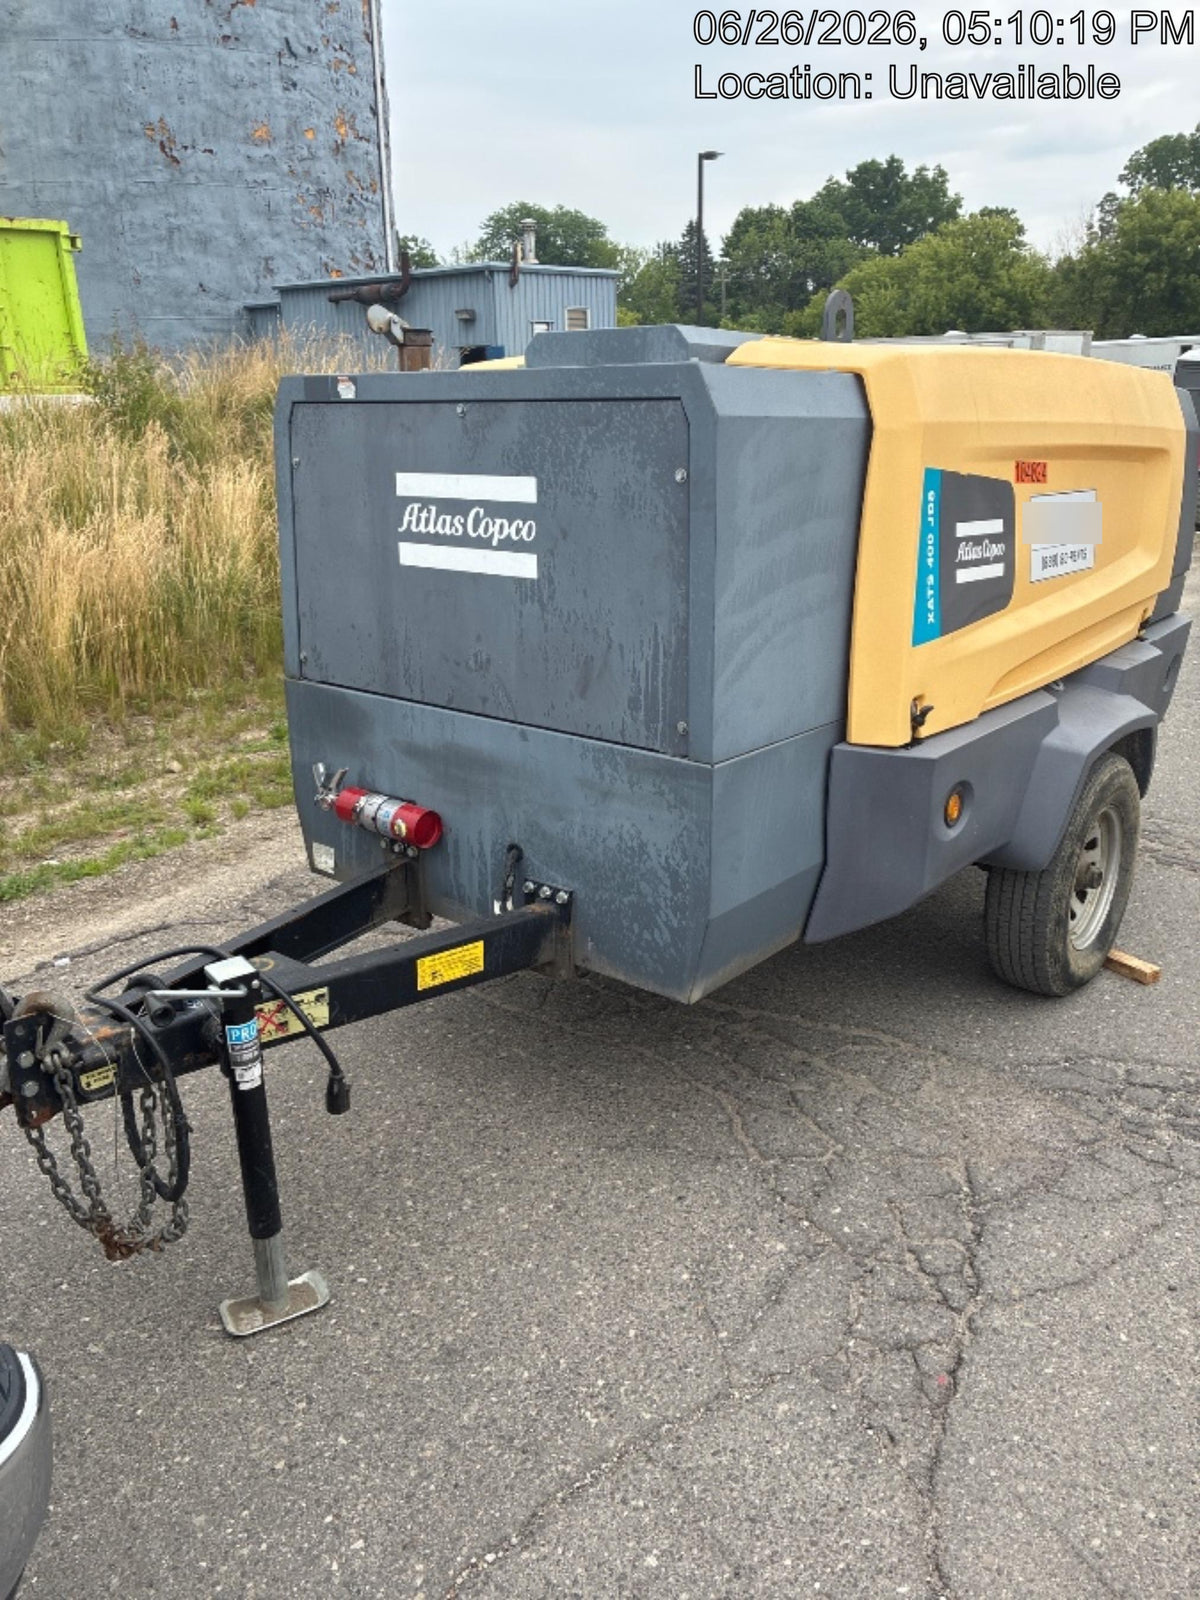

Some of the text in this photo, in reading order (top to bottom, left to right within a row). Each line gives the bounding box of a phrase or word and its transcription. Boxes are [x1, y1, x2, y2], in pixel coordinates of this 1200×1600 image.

[398, 502, 536, 546] Atlas Copco
[926, 533, 936, 568] 400
[954, 538, 1006, 563] Atlas Copco
[926, 574, 936, 624] XATS
